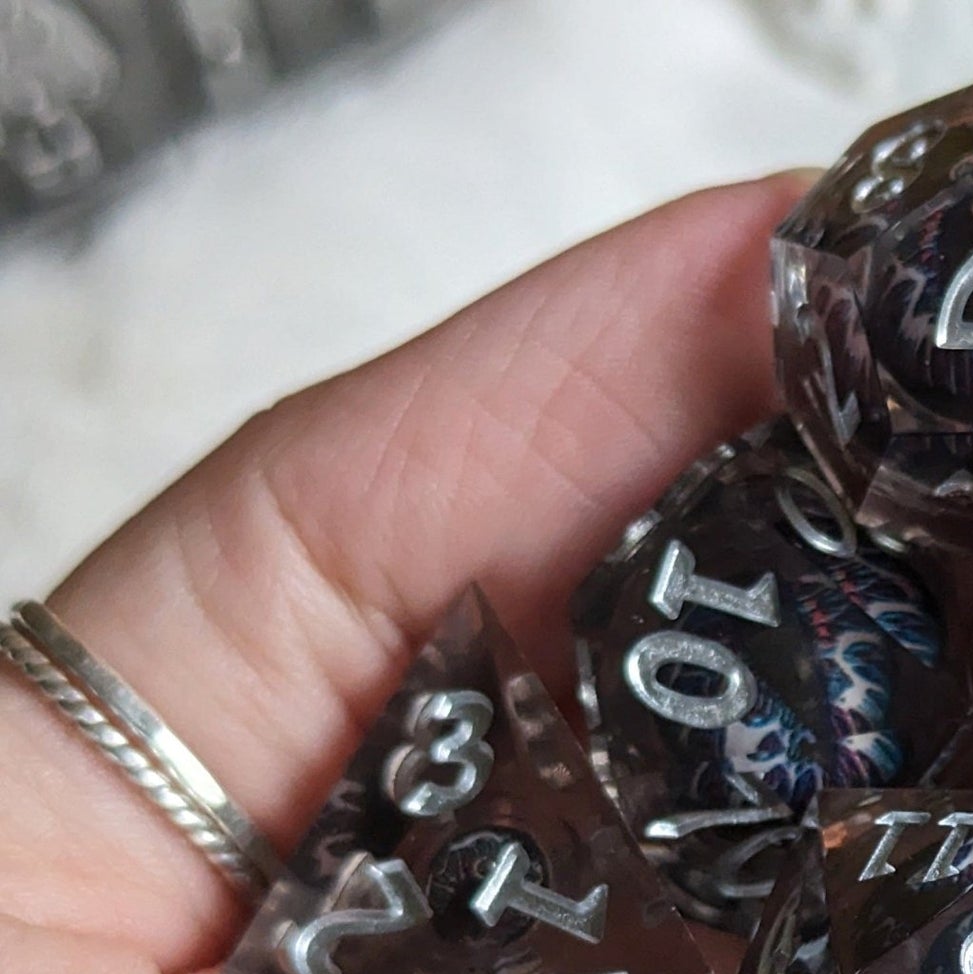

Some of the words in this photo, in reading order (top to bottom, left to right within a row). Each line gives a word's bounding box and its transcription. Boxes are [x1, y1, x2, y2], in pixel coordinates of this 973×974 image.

[622, 538, 782, 730] 10
[385, 690, 495, 818] 3
[470, 842, 609, 944] 1
